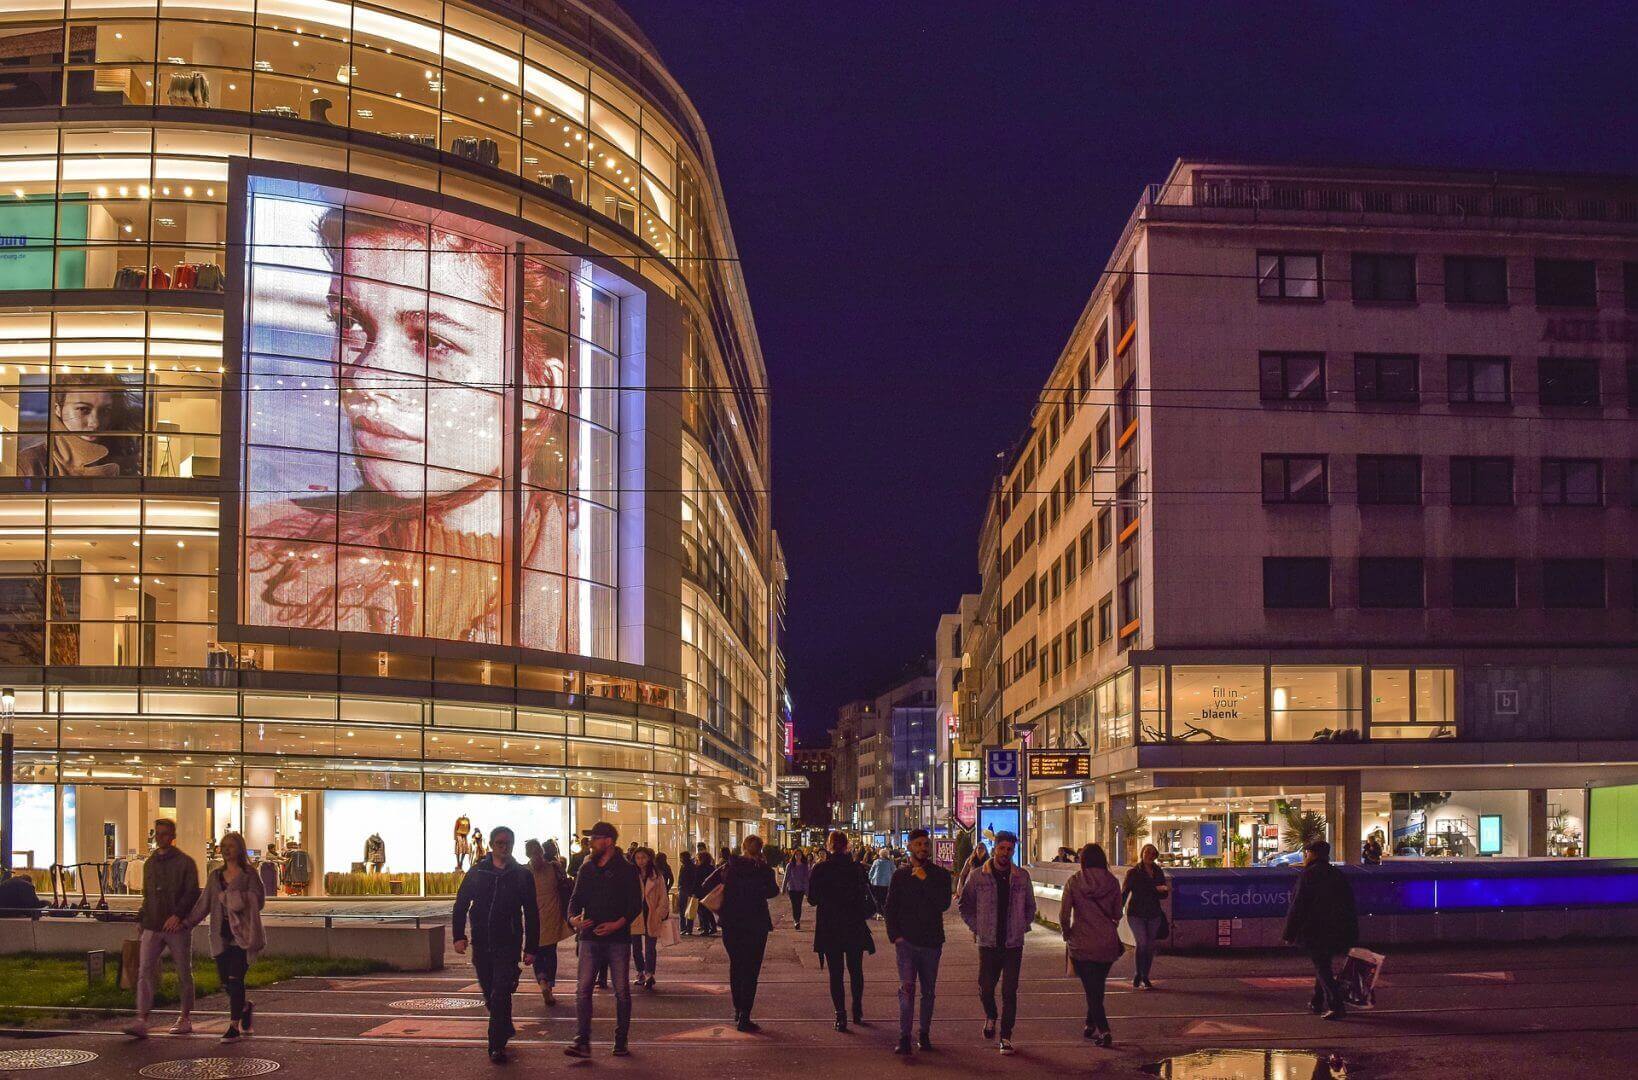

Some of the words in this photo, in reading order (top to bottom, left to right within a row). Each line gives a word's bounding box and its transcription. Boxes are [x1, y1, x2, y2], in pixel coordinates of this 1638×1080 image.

[1213, 687, 1225, 697] fill
[1228, 688, 1238, 697] in
[1214, 700, 1238, 709] your
